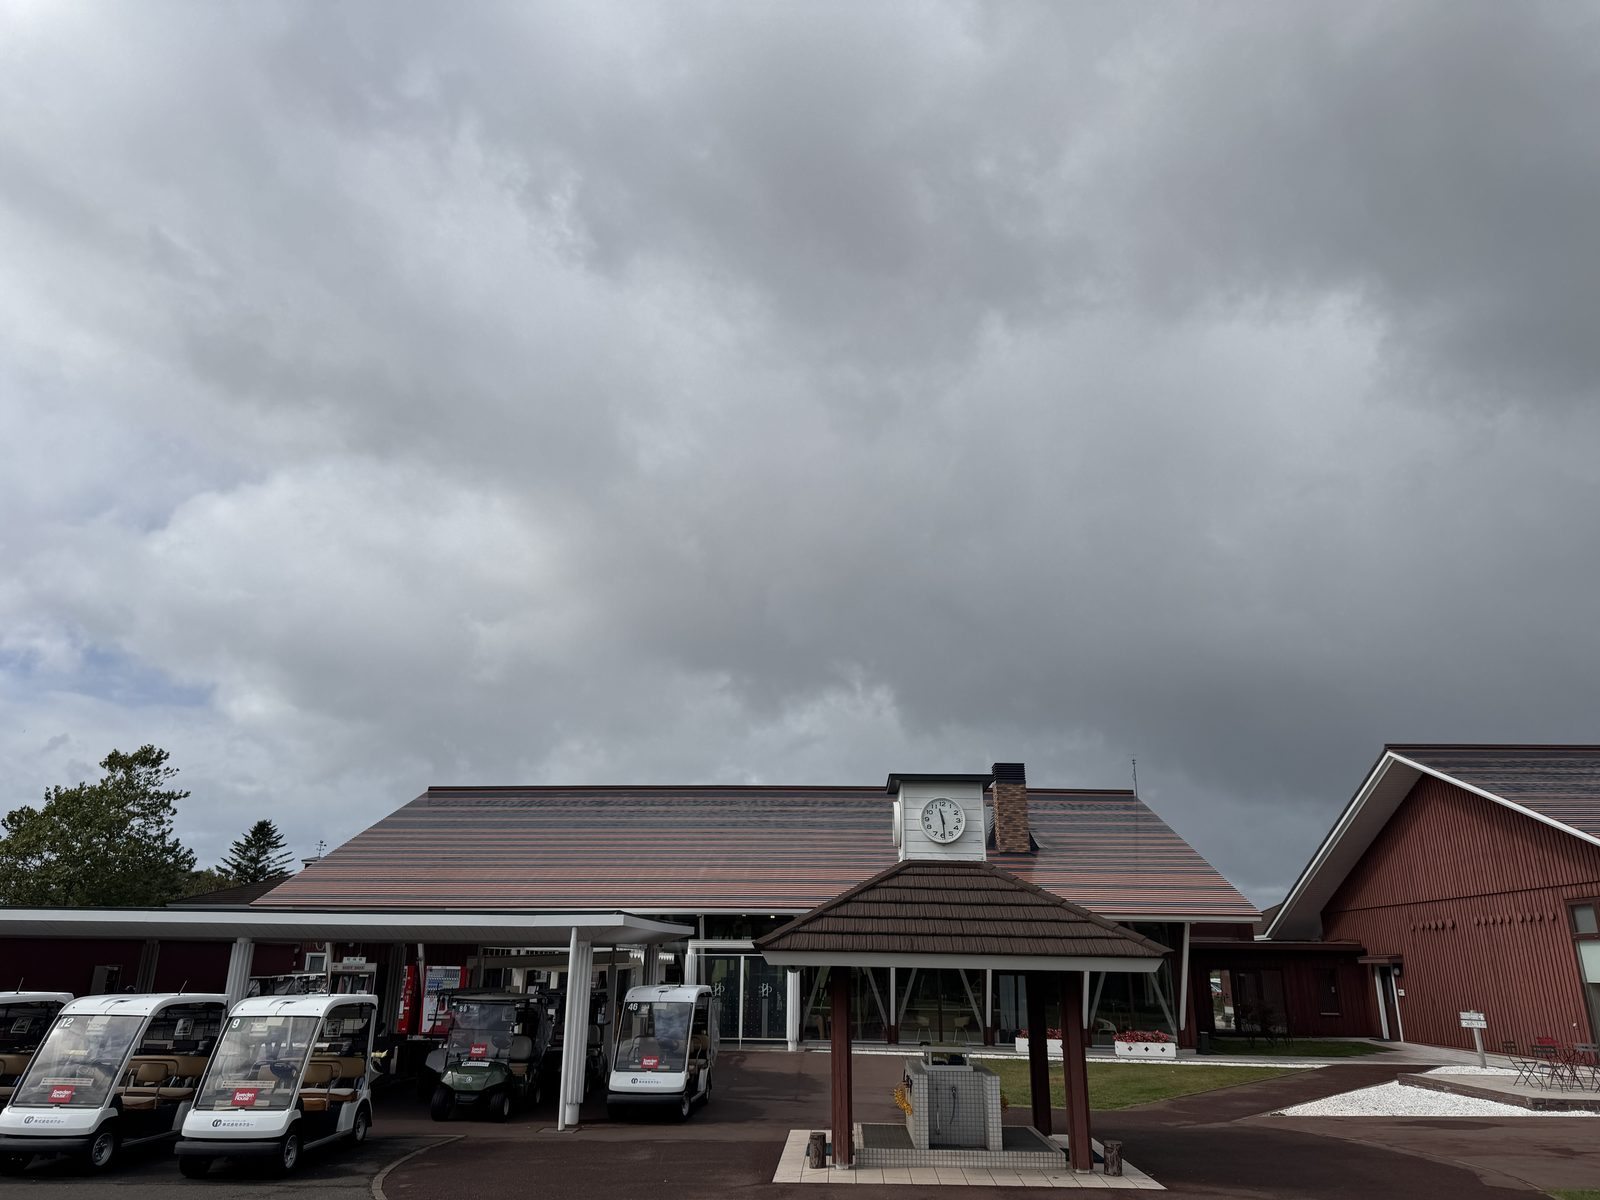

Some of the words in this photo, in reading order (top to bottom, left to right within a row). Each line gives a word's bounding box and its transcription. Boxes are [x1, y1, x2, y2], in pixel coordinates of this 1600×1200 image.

[628, 1002, 638, 1010] 46
[60, 1018, 74, 1028] 12
[232, 1018, 240, 1028] 9
